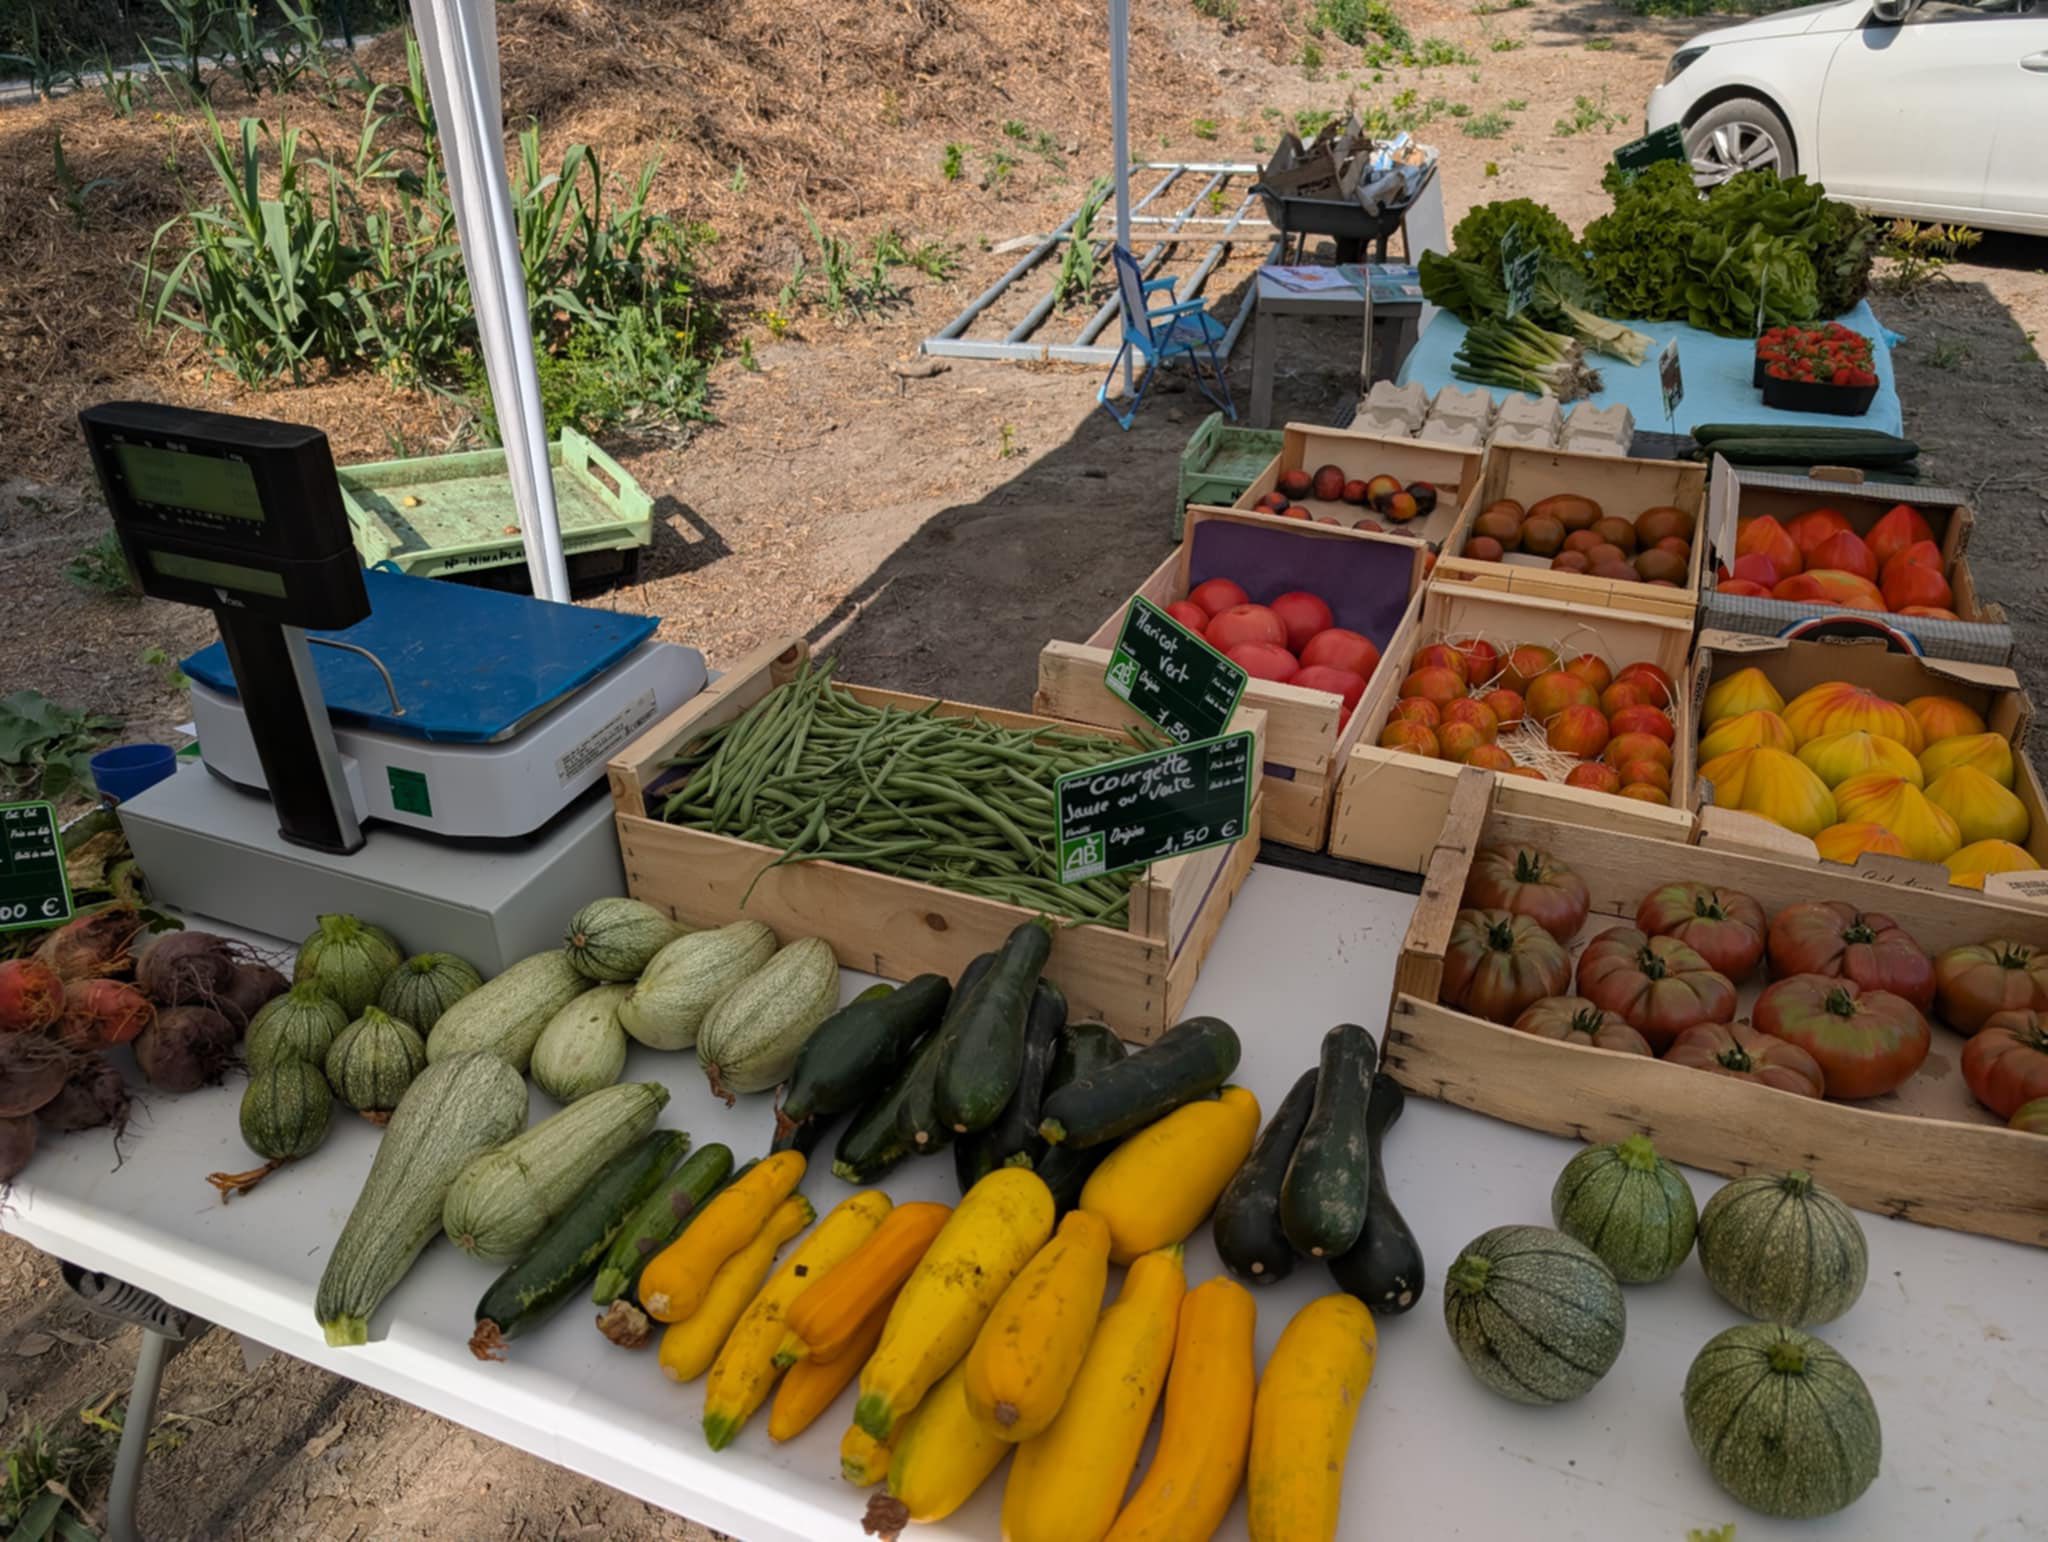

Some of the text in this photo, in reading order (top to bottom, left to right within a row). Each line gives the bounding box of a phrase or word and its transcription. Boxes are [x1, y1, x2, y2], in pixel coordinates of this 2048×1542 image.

[1136, 610, 1178, 654] Haricot
[1112, 662, 1132, 685] AB
[1160, 655, 1190, 683] Vert
[1090, 753, 1192, 796] Courgette
[1064, 777, 1195, 824] Jaune ou Verte
[1155, 819, 1238, 854] 1,50 €
[1066, 846, 1098, 870] AB
[41, 897, 60, 916] €
